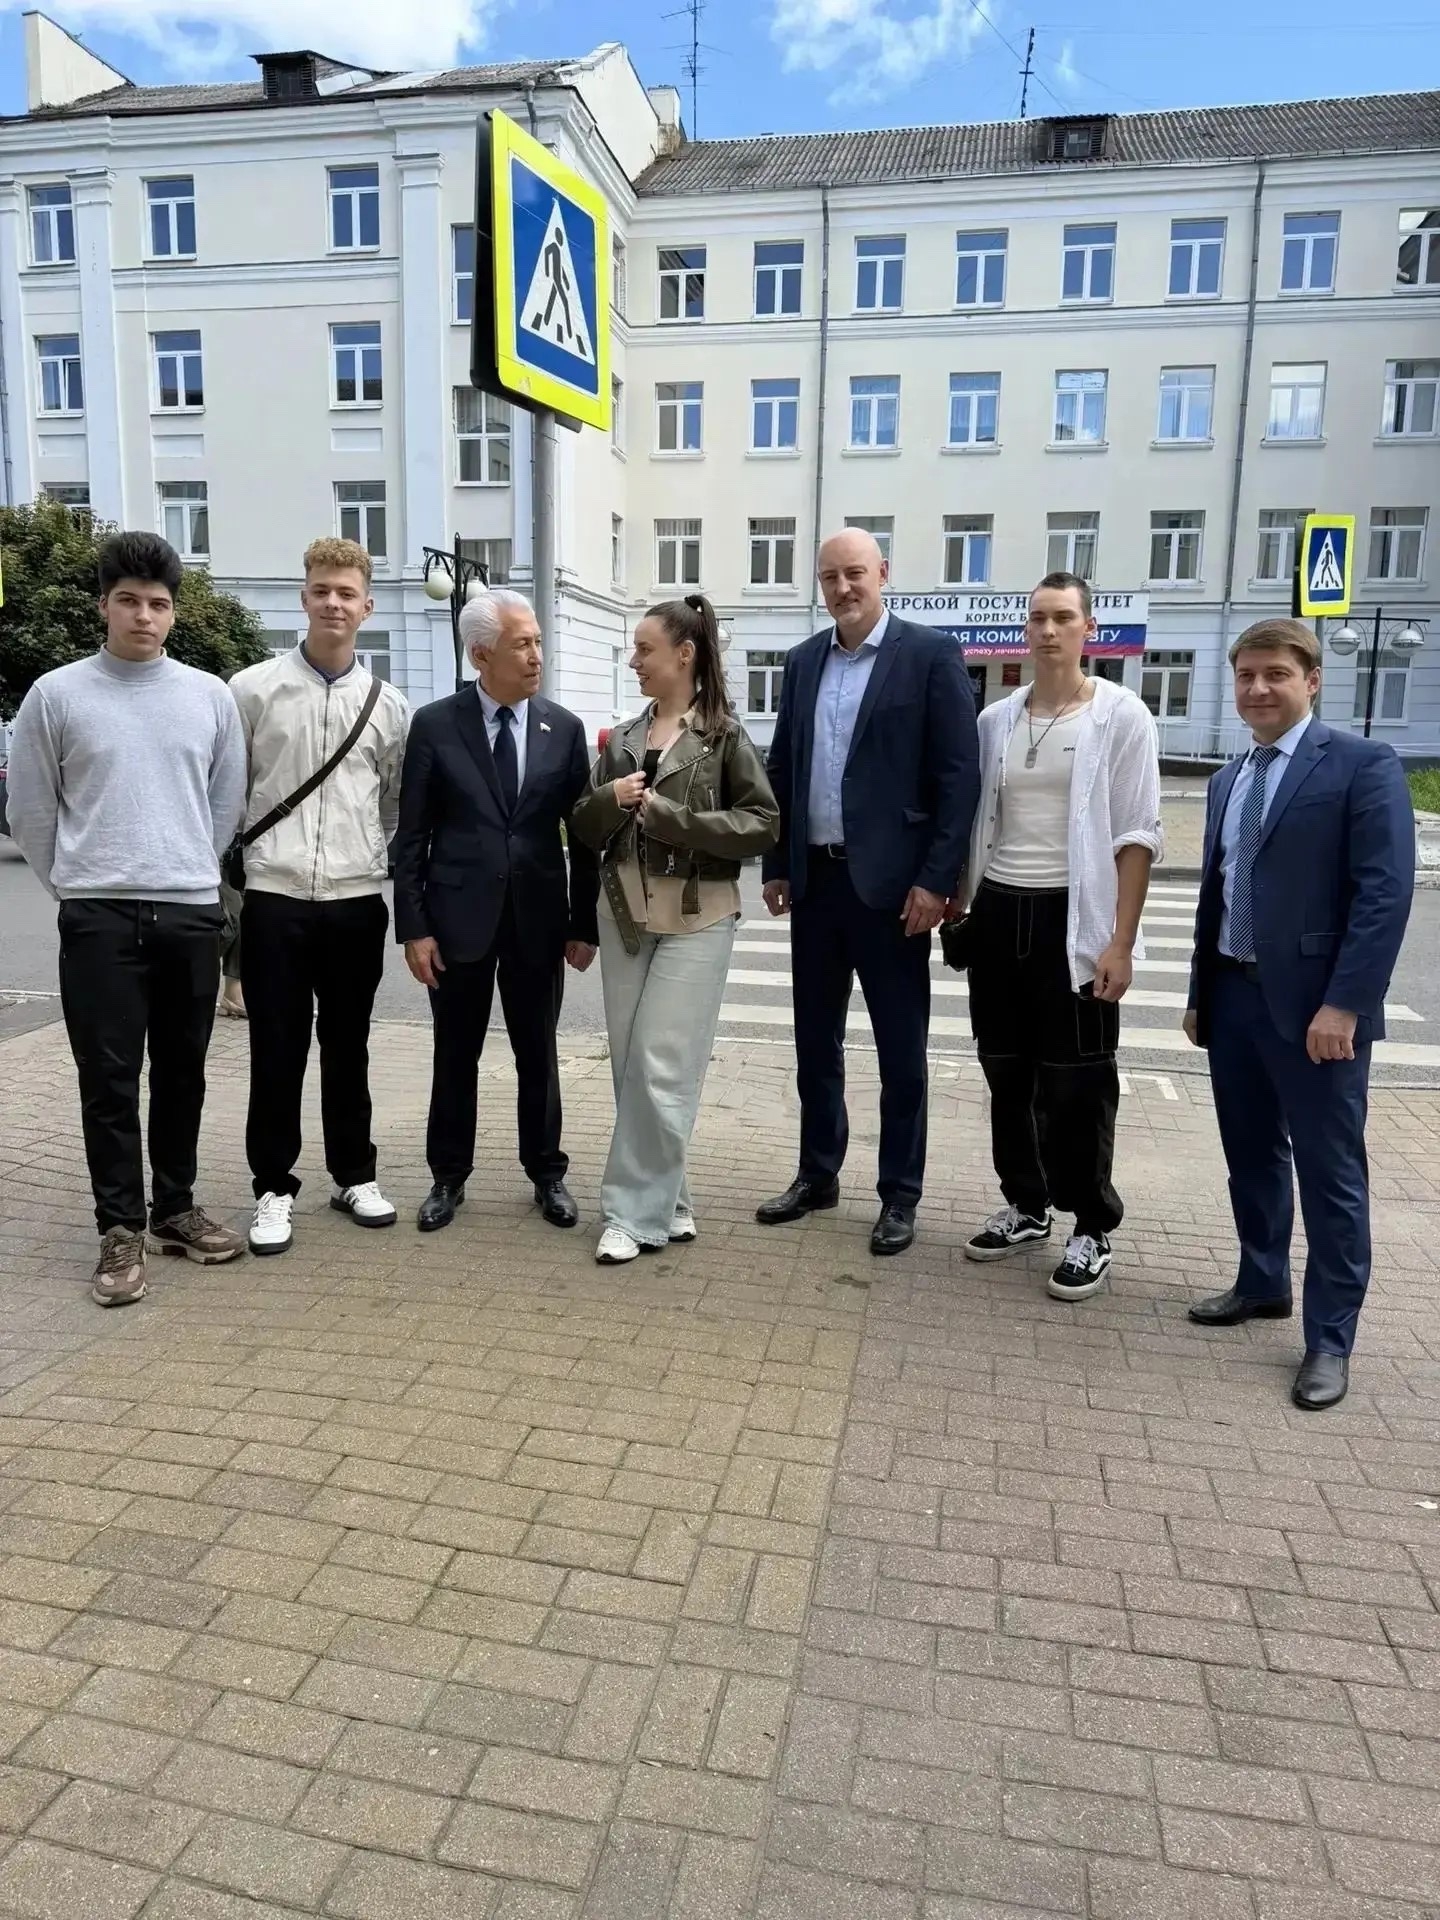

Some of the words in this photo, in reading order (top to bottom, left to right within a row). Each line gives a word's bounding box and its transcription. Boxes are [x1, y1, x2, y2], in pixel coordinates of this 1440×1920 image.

[881, 594, 959, 610] ВЕРСКОЙ
[966, 613, 1016, 623] КОРПУС
[976, 630, 1026, 643] КОМИ
[1087, 629, 1121, 642] ВГУ
